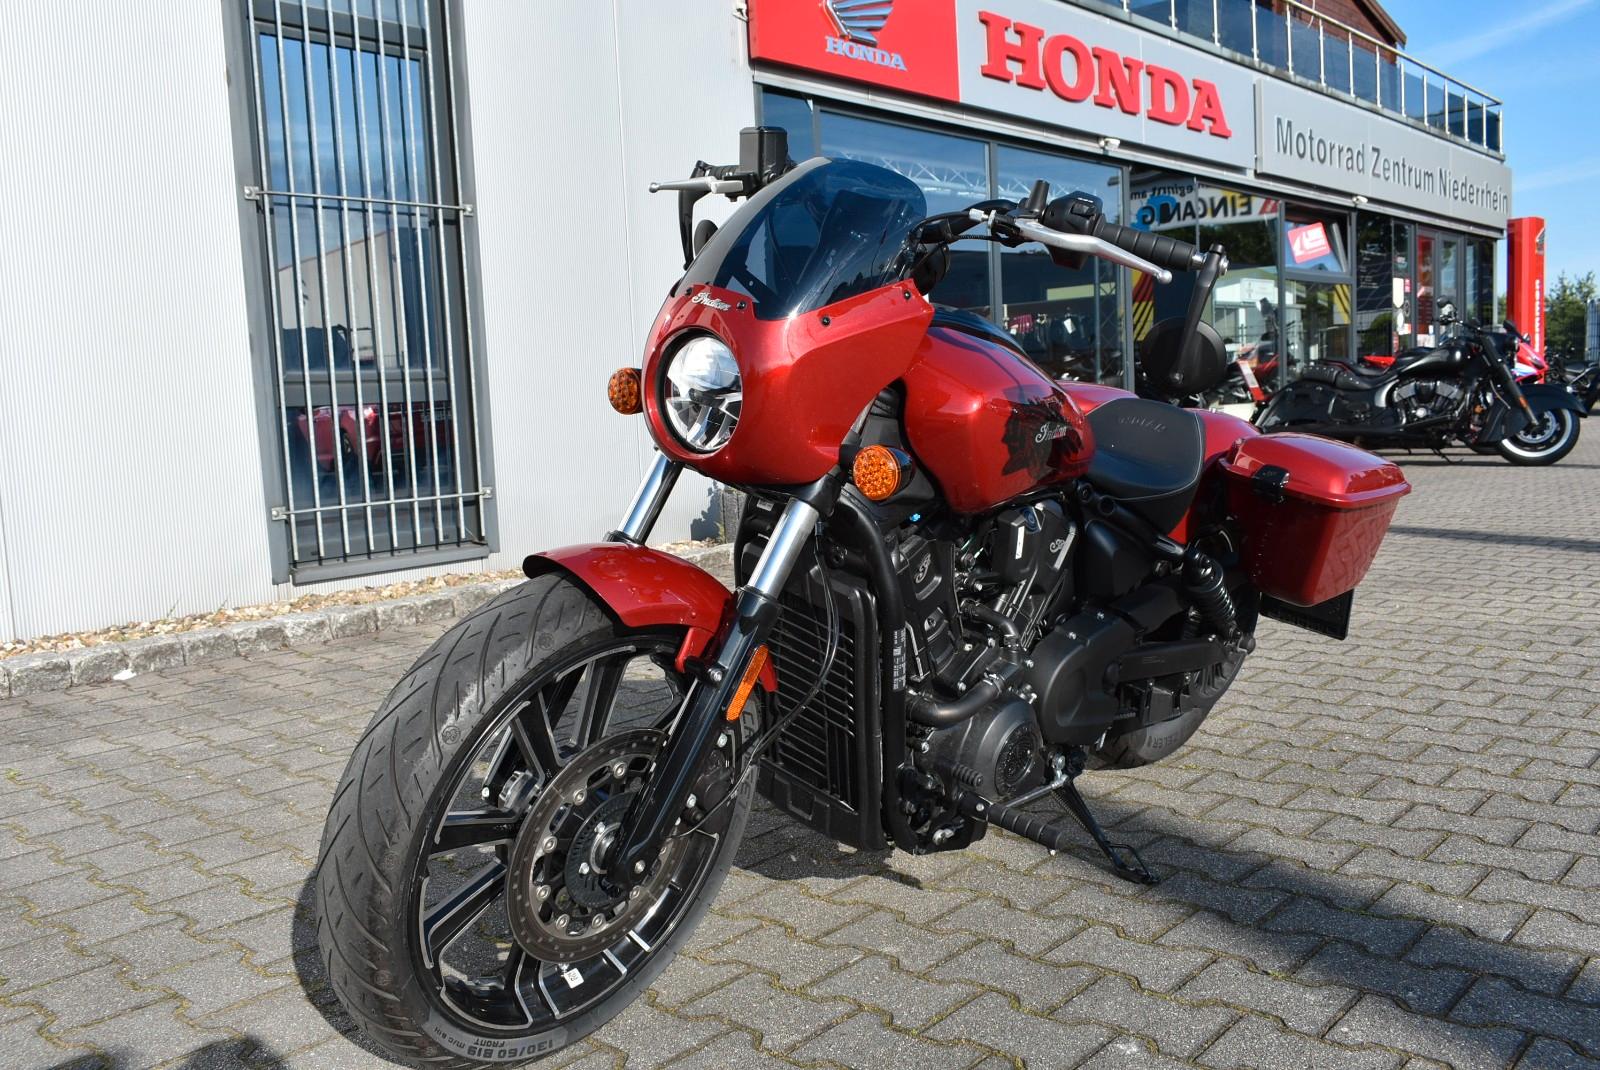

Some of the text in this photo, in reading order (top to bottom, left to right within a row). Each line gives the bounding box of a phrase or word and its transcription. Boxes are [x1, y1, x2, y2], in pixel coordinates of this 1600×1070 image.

[825, 35, 908, 71] HONDA
[978, 11, 1232, 139] HONDA
[1276, 117, 1508, 214] Motorrad Zentrum Niederrhein
[1035, 423, 1068, 443] Indian
[467, 1045, 494, 1058] B19
[474, 1038, 505, 1047] FRONT
[498, 1039, 553, 1058] 130/60
